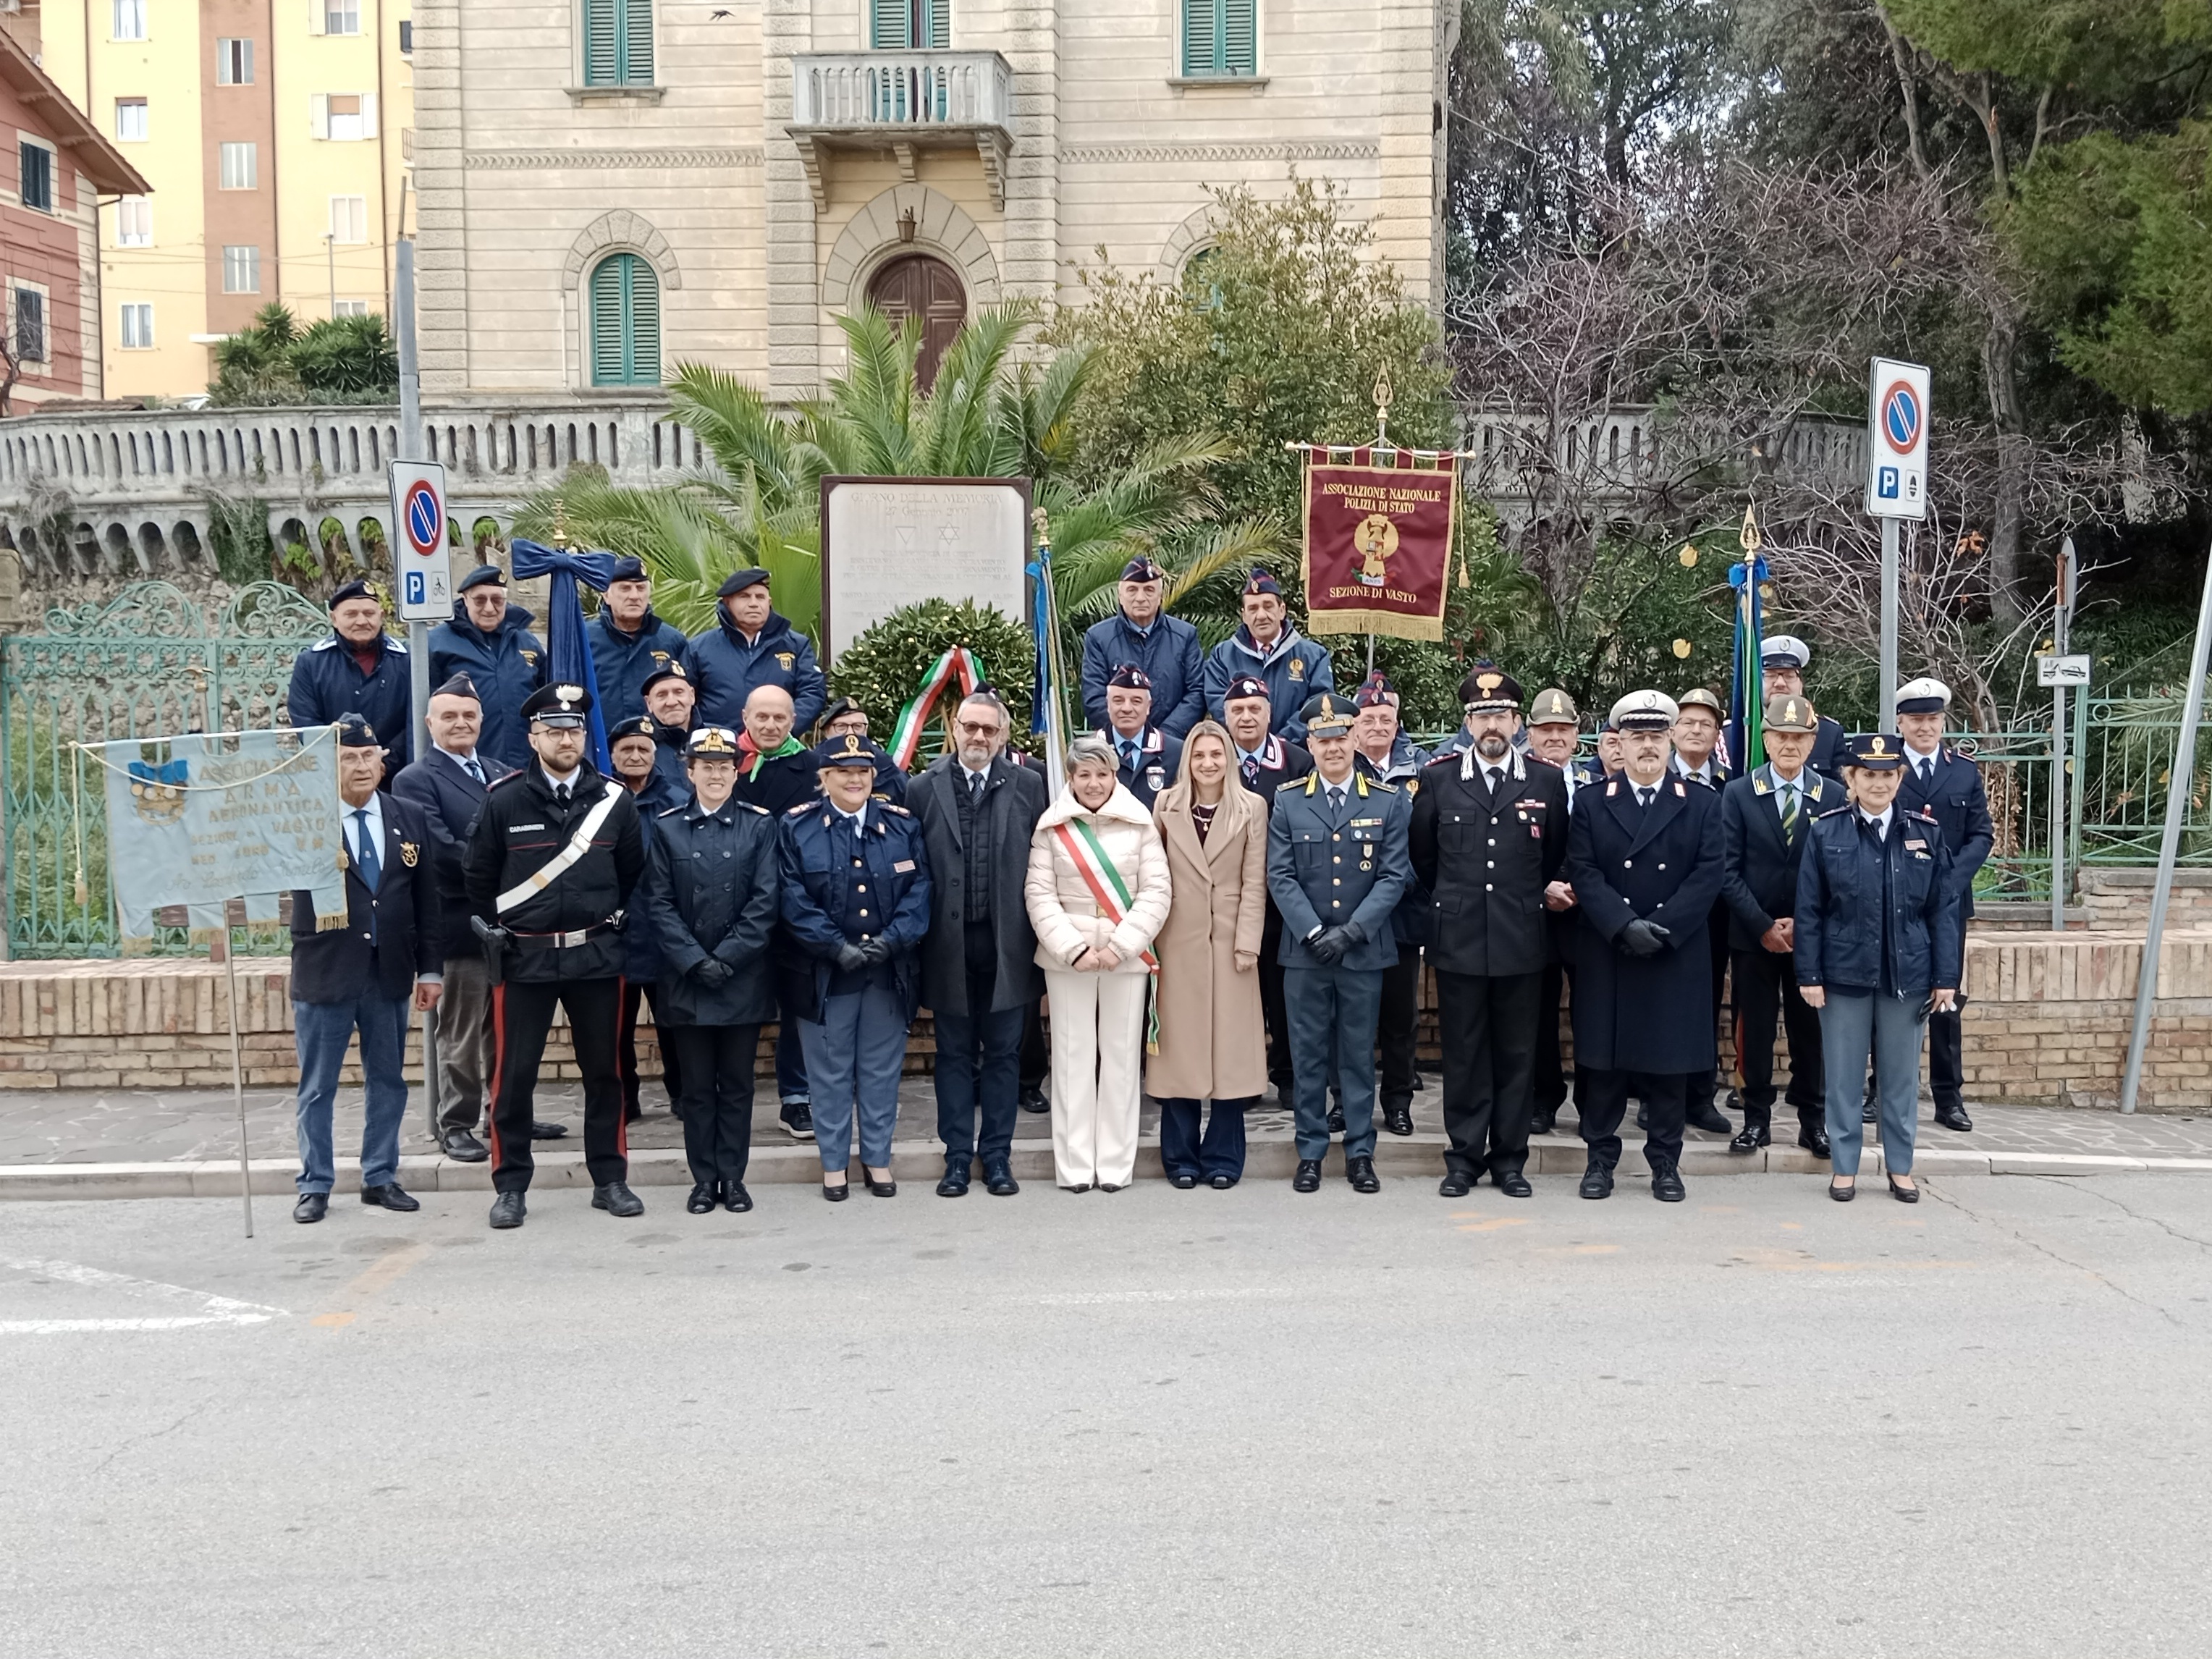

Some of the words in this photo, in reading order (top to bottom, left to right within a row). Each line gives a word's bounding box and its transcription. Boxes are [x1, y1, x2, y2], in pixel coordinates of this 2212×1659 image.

[1322, 484, 1386, 499] ASSOCIAZIONE
[1389, 488, 1441, 502] NAZIONALE
[1883, 470, 1896, 495] P
[850, 493, 895, 503] GIORNO
[899, 493, 938, 504] DELLA
[942, 494, 1002, 505] MEMORIA
[1344, 497, 1376, 511] POLIZIA
[1378, 500, 1388, 512] DI
[1389, 502, 1415, 514] STATO
[885, 507, 897, 516] 27
[946, 507, 969, 517] 2007
[410, 575, 421, 601] P
[1329, 585, 1370, 599] SEZIONE
[1371, 587, 1382, 599] DI
[1385, 588, 1417, 604] VASTO
[199, 755, 318, 782] ASSOCIAZIONE
[209, 798, 324, 823] AERONAUTICA
[191, 830, 237, 846] SEZIONE
[271, 817, 325, 835] VASTO
